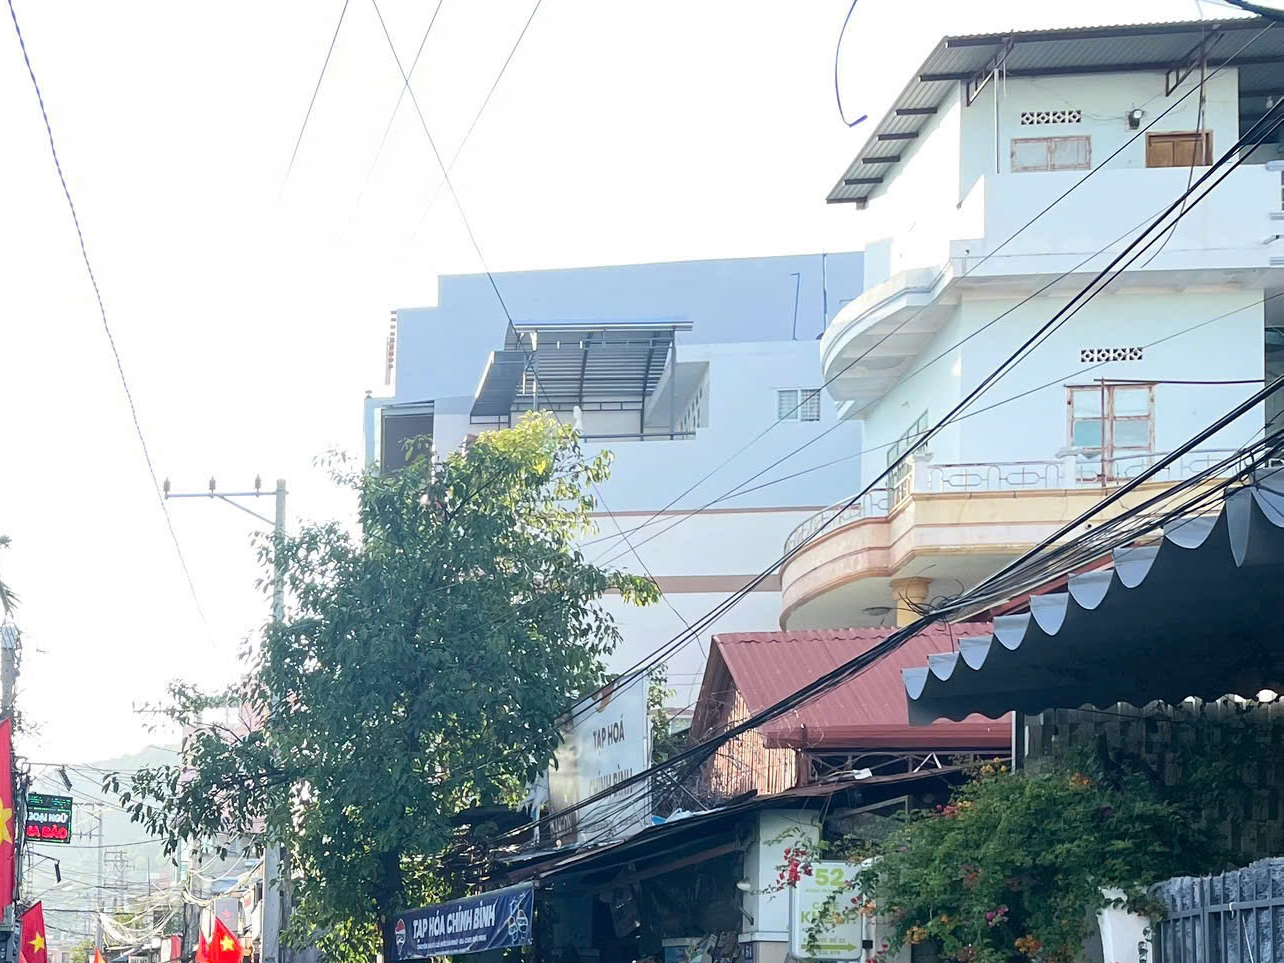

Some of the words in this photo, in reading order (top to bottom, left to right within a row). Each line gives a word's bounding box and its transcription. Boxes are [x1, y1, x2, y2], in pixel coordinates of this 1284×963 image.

[592, 727, 607, 756] TẠP
[607, 713, 625, 747] HOÁ
[815, 868, 845, 887] 52
[413, 918, 429, 944] TẠP
[429, 910, 446, 937] HÓA
[446, 905, 473, 935] CHÍNH
[473, 900, 497, 930] BÌNH
